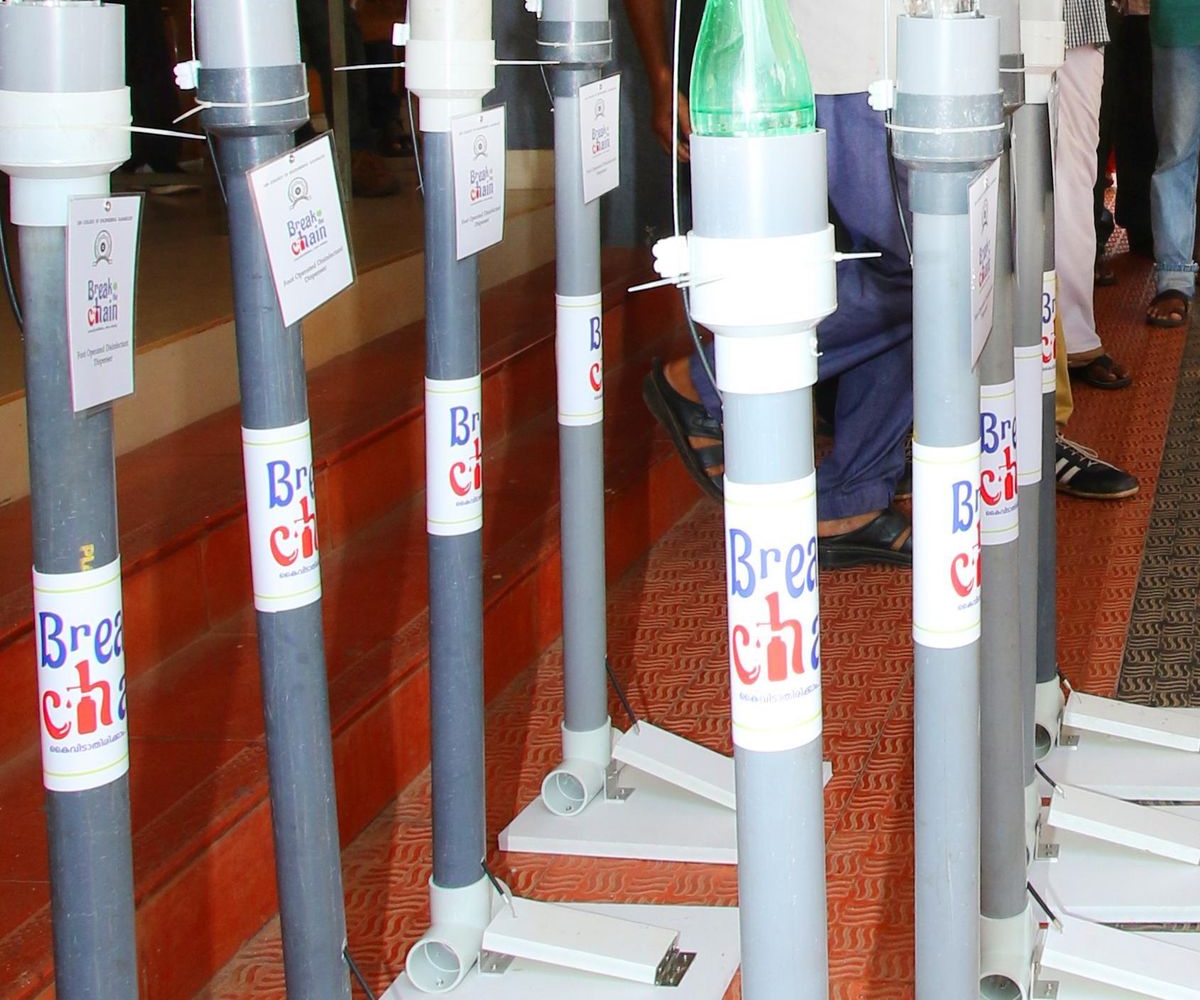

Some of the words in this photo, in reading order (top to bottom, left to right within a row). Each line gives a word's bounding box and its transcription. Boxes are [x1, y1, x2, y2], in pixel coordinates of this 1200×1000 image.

[286, 210, 317, 238] Break
[291, 225, 328, 256] chain
[87, 277, 113, 301] Break
[87, 297, 118, 327] chain
